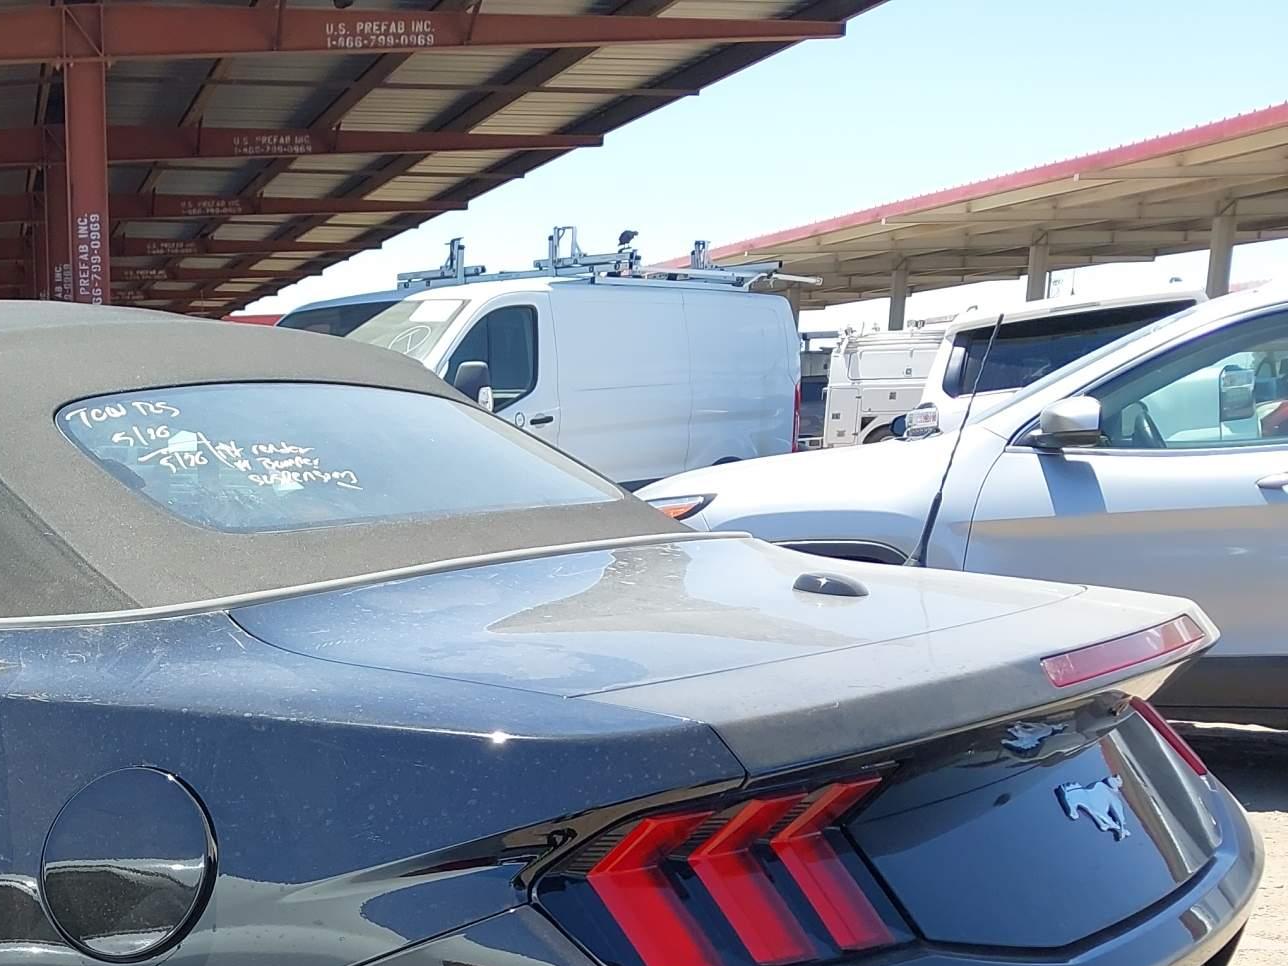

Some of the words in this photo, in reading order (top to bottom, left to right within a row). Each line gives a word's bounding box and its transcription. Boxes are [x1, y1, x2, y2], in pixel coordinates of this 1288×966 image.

[326, 22, 350, 35] U.S.
[356, 21, 405, 34] PREFAB
[411, 20, 436, 33] INC.
[327, 34, 434, 48] 1-866-799-0969
[77, 213, 89, 239] INC.
[78, 244, 90, 295] PREFAB
